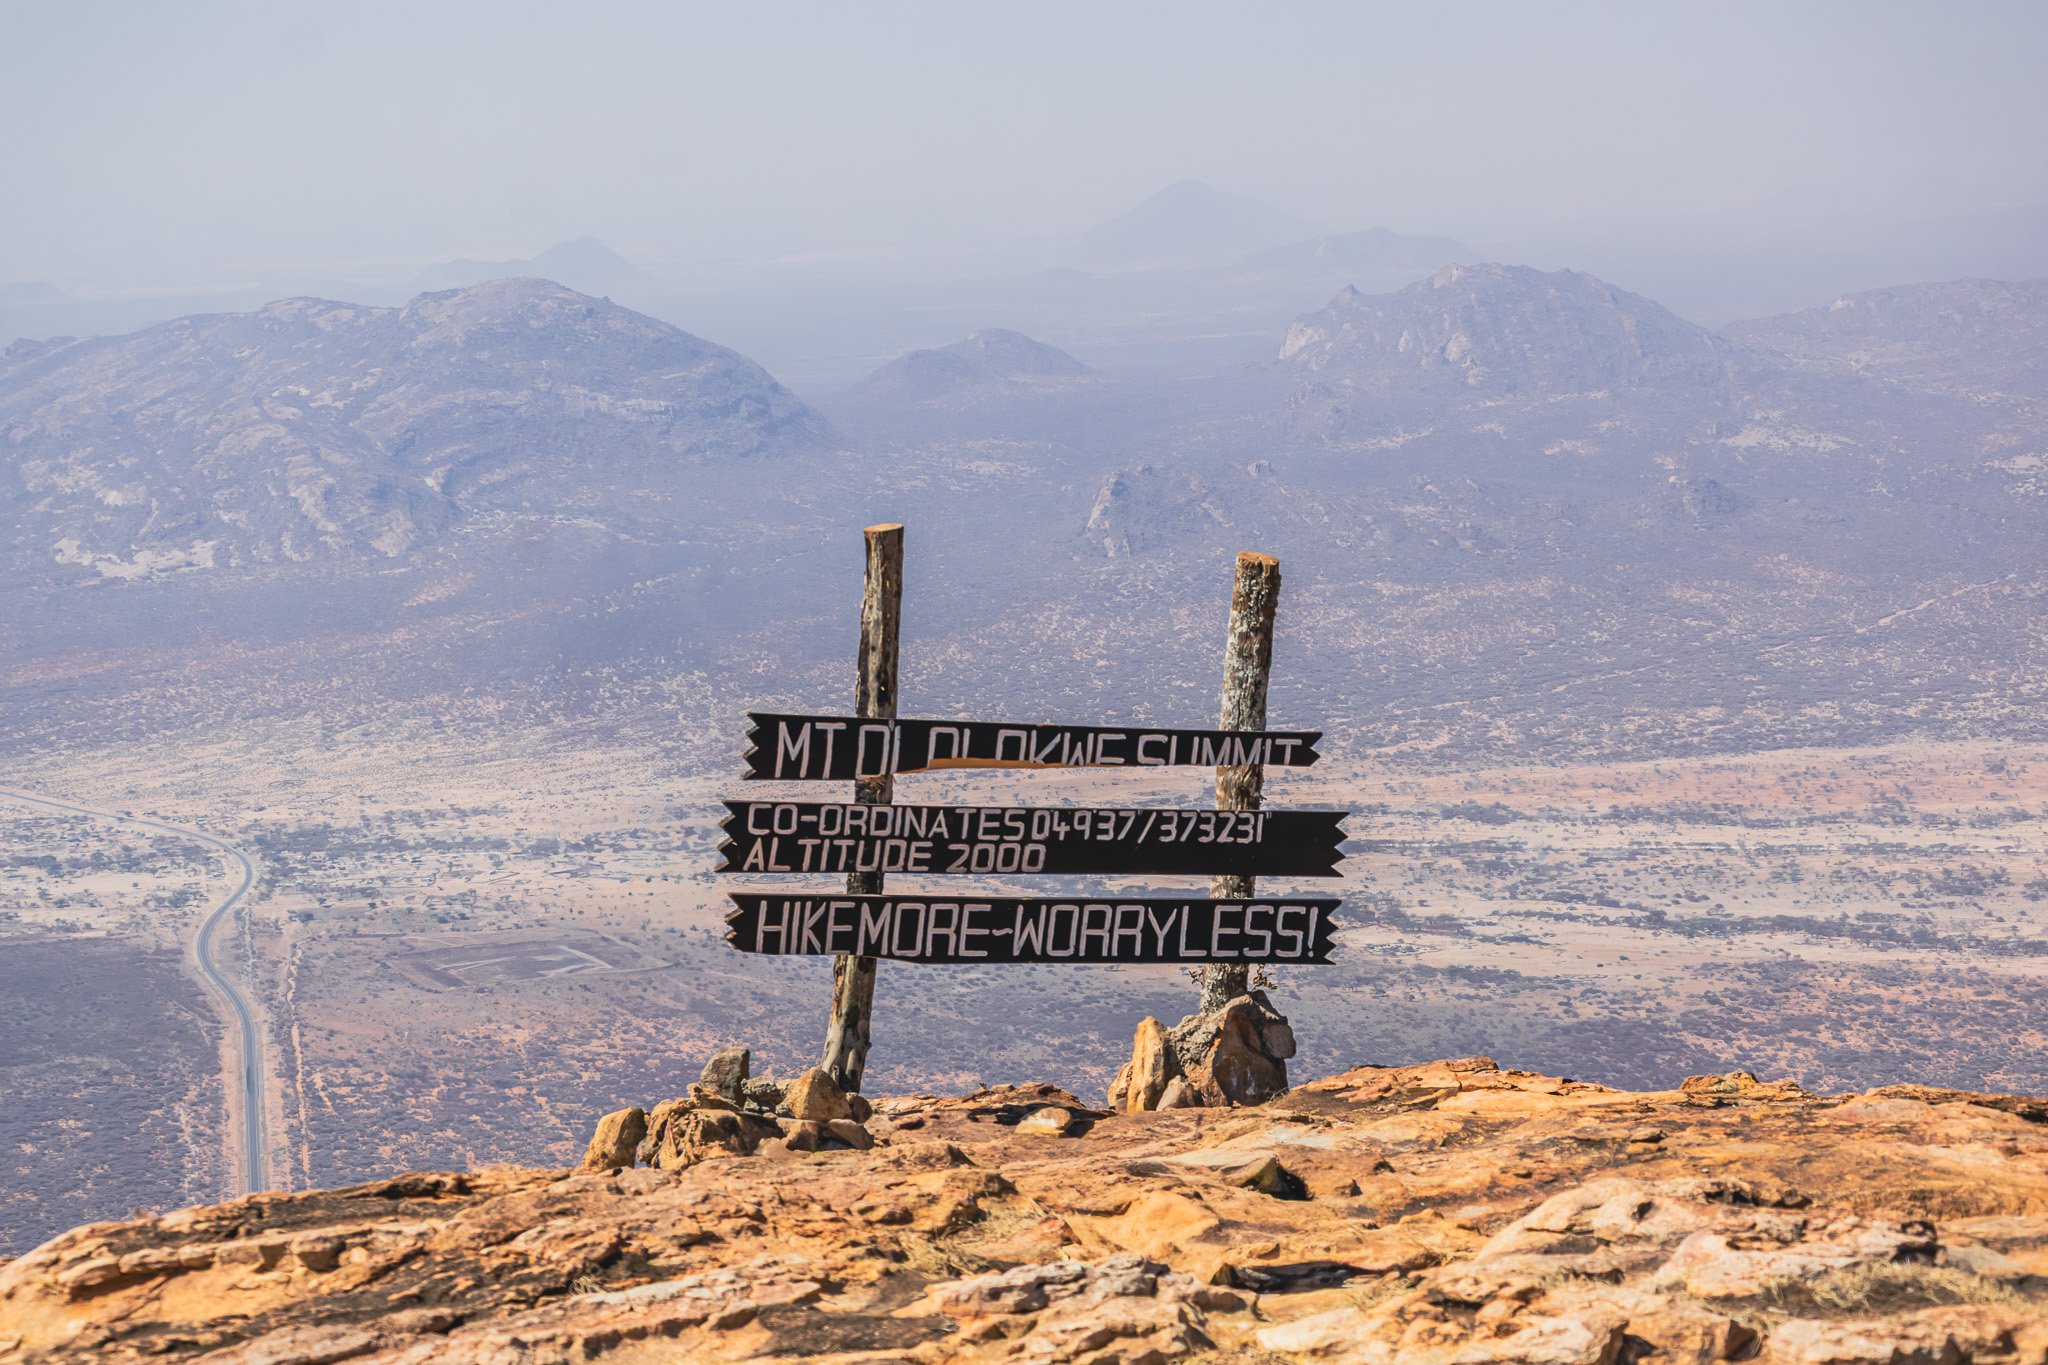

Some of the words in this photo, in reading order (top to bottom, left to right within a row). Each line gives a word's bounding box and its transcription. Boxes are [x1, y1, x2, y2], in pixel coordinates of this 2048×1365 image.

[775, 721, 847, 780] MT
[748, 803, 1026, 841] CO-ORDINATES
[743, 837, 934, 873] ALTITUDE
[946, 843, 1047, 874] 2000
